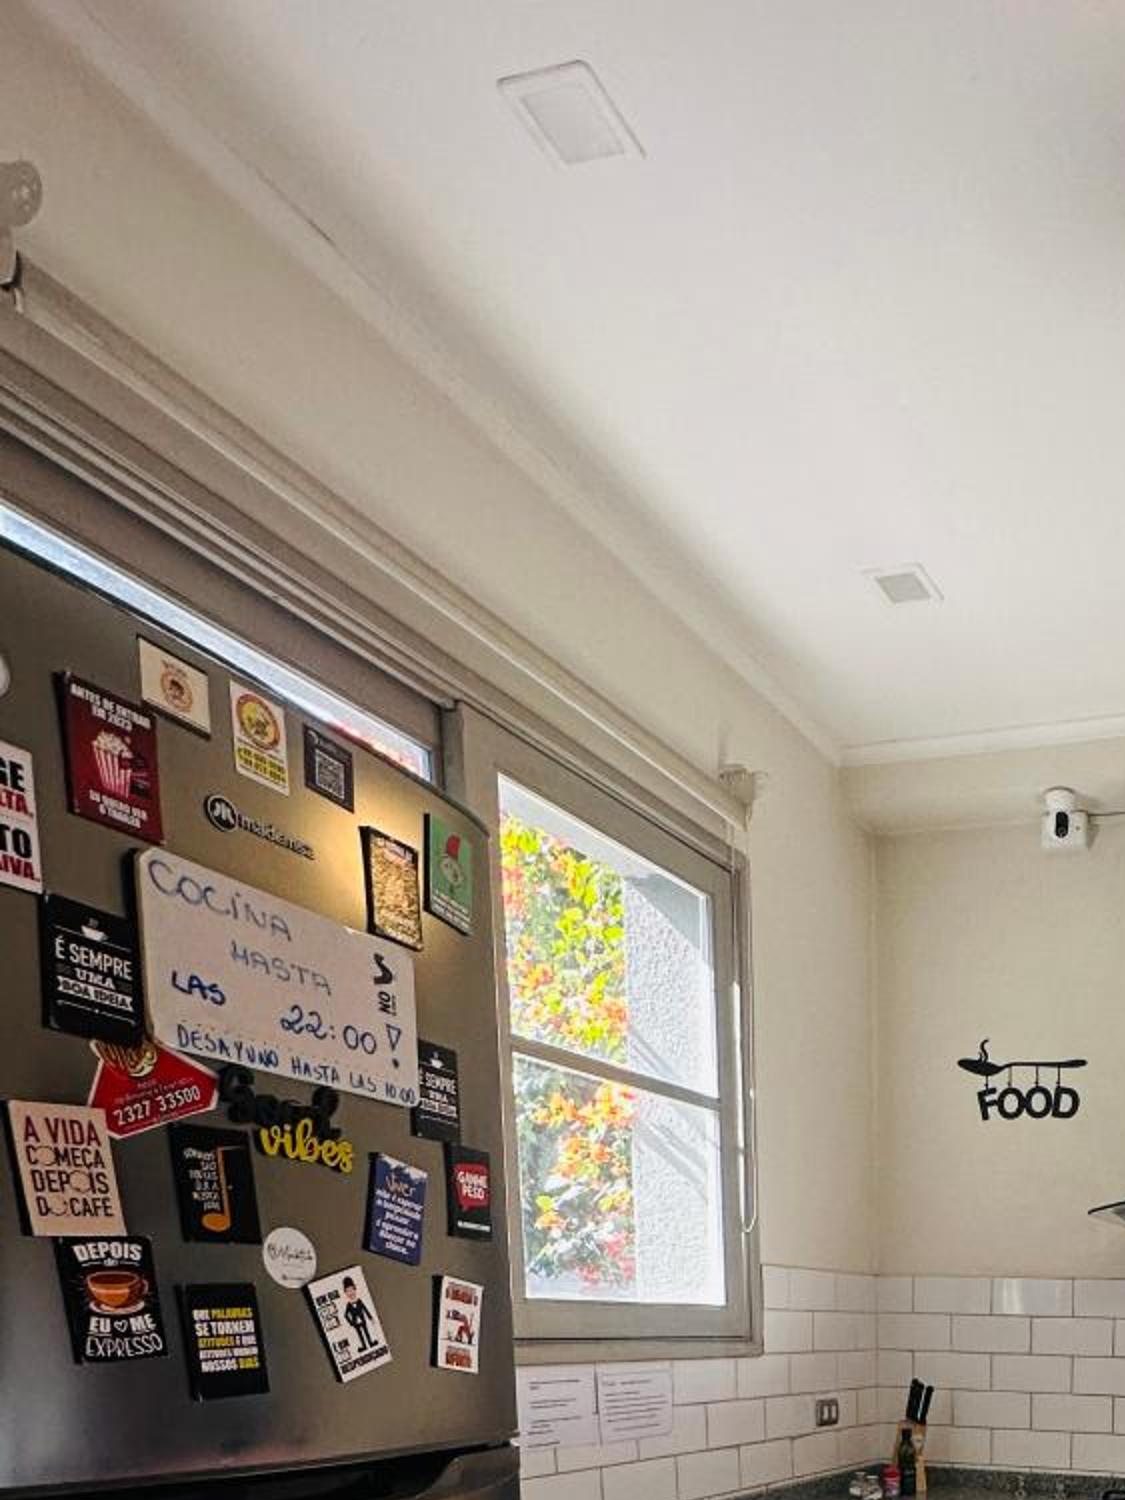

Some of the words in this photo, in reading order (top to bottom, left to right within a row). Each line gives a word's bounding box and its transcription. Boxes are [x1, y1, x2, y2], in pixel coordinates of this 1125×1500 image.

[55, 936, 65, 959] É
[69, 944, 133, 981] SEMPRE
[231, 941, 332, 996] HASTA
[75, 967, 115, 989] UMA
[172, 970, 227, 1006] LAS
[177, 1024, 279, 1068] DESAYUNO
[291, 1056, 340, 1084] HASTA
[350, 1072, 377, 1093] LAS
[425, 1073, 457, 1095] SEMPRE
[977, 1086, 1080, 1121] FOOD
[24, 1116, 40, 1142] A
[44, 1117, 101, 1146] VIDA
[25, 1145, 105, 1169] COMEÇA
[260, 1118, 352, 1174] vibes
[31, 1169, 109, 1194] DEPOIS
[72, 1241, 142, 1262] DEPOIS
[89, 1316, 111, 1333] EU
[129, 1314, 156, 1332] ME
[195, 1322, 210, 1337] SE
[85, 1333, 163, 1357] EXPRESSO
